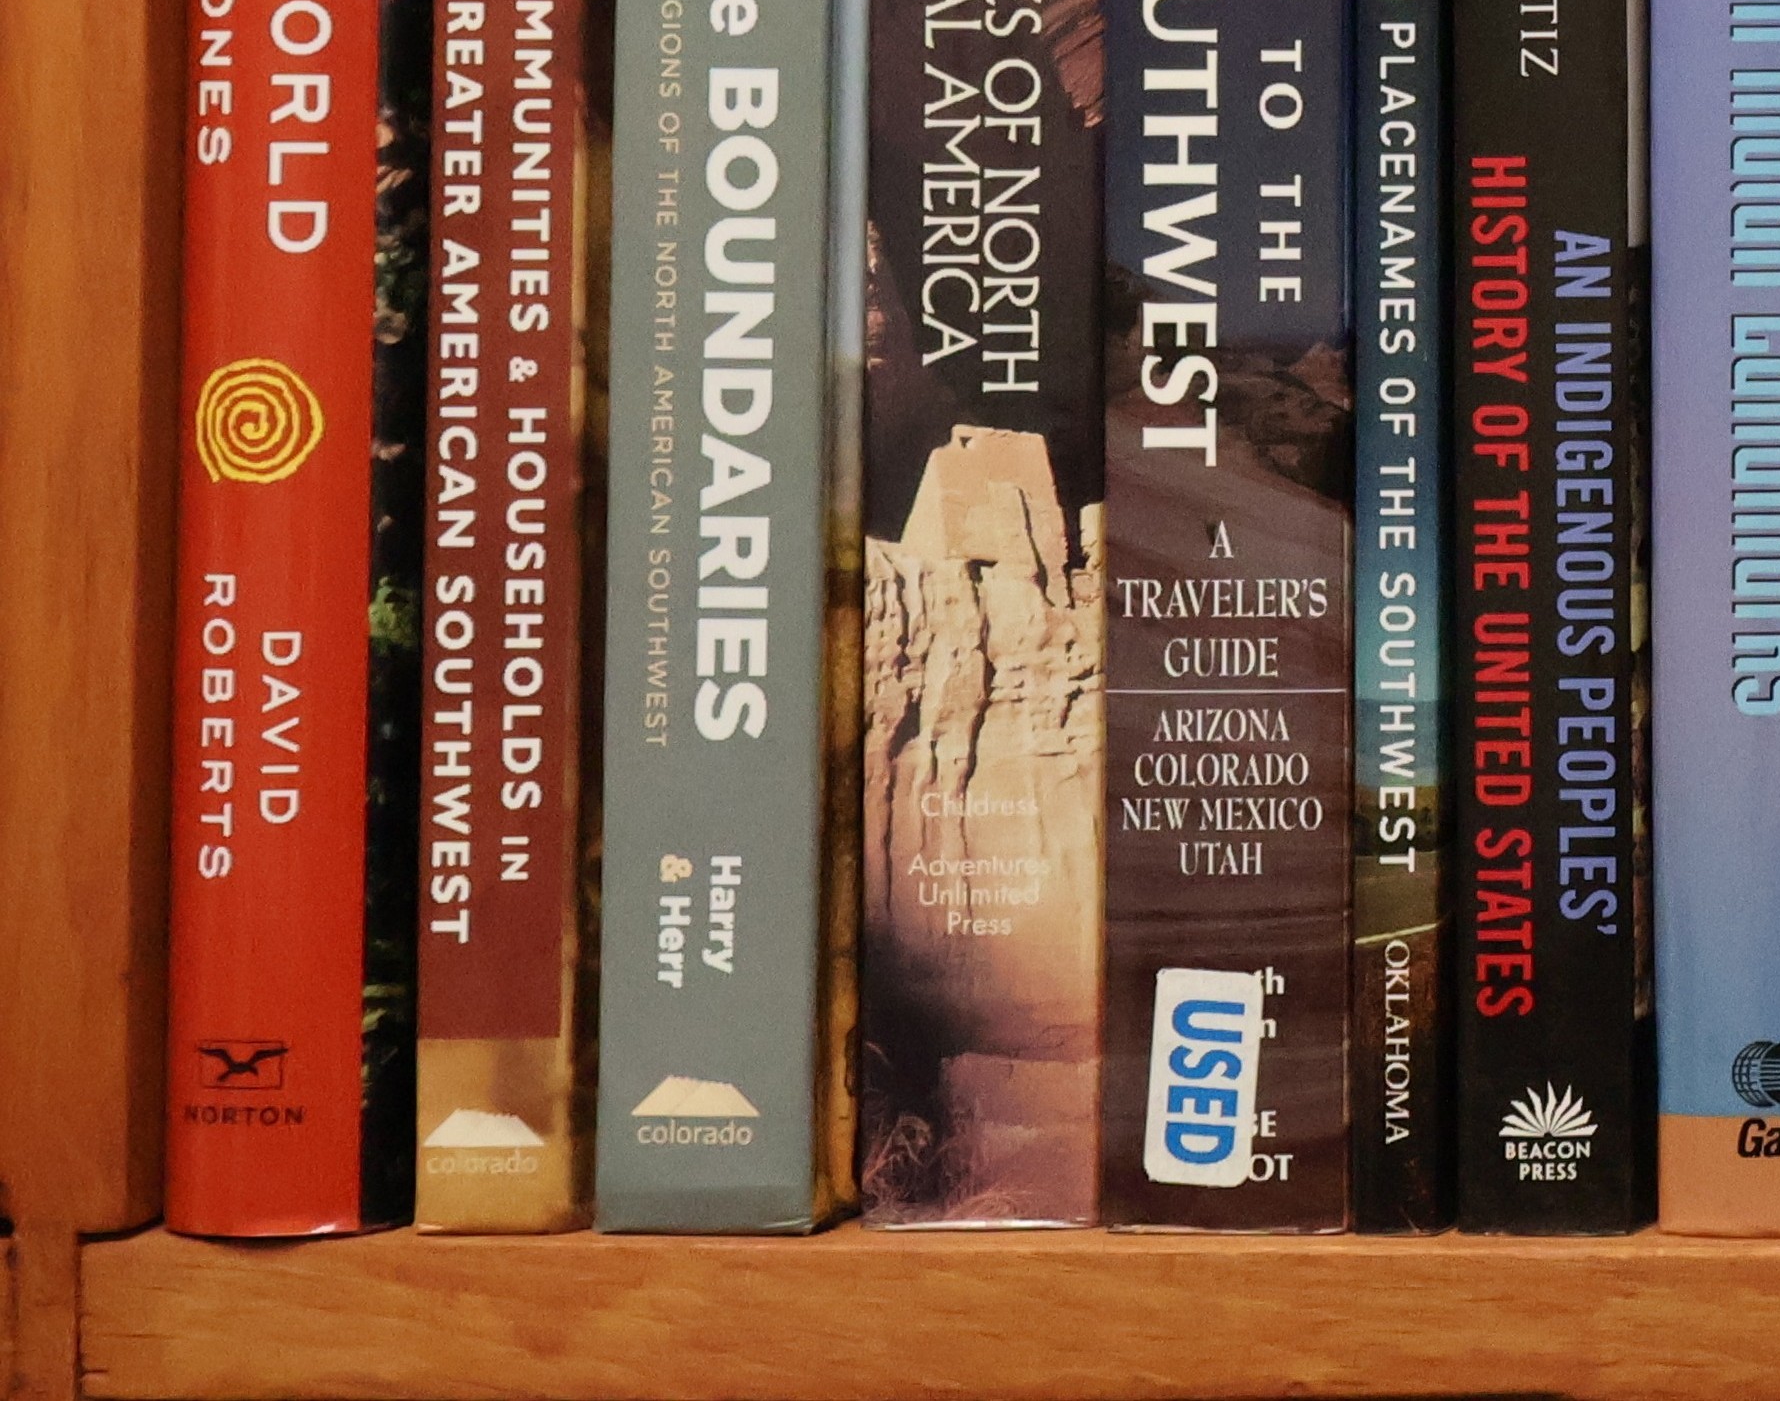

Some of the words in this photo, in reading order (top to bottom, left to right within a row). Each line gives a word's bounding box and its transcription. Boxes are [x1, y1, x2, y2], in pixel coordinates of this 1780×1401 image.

[658, 112, 680, 153] OF
[656, 169, 679, 225] THE
[1380, 23, 1416, 354] PLACENAMES
[1555, 230, 1611, 297] AN
[655, 242, 677, 350] NORTH
[509, 357, 537, 382] &
[695, 68, 779, 740] BOUNDARIES
[1380, 378, 1415, 437] OF
[650, 365, 674, 533] AMERICAN
[1379, 458, 1415, 549] THE
[1555, 323, 1614, 656] INDIGENOUS
[502, 408, 546, 809] HOUSEHOLDS
[645, 549, 671, 746] SOUTHWEST
[1164, 638, 1278, 677] GUIDE
[199, 574, 235, 878] ROBERTS
[260, 632, 301, 823] DAVID
[1153, 709, 1289, 742] ARIZONA
[1378, 572, 1418, 872] SOUTHWEST
[1135, 753, 1308, 787] COLORADO
[1122, 798, 1190, 831] NEW
[1200, 797, 1322, 831] MEXICO
[501, 837, 529, 880] IN
[660, 855, 692, 883] &
[907, 852, 1050, 877] Adventures
[1180, 842, 1262, 875] UTAH
[702, 856, 742, 973] Harry
[918, 879, 1040, 907] Unlimited
[658, 896, 691, 988] Herr
[947, 911, 1013, 936] Press
[1385, 939, 1410, 1144] OKLAHOMA
[1165, 1000, 1245, 1164] USED
[183, 1105, 305, 1126] NORTON
[637, 1119, 752, 1145] colorado
[1506, 1141, 1590, 1159] BEACON
[1520, 1163, 1577, 1180] PRESS
